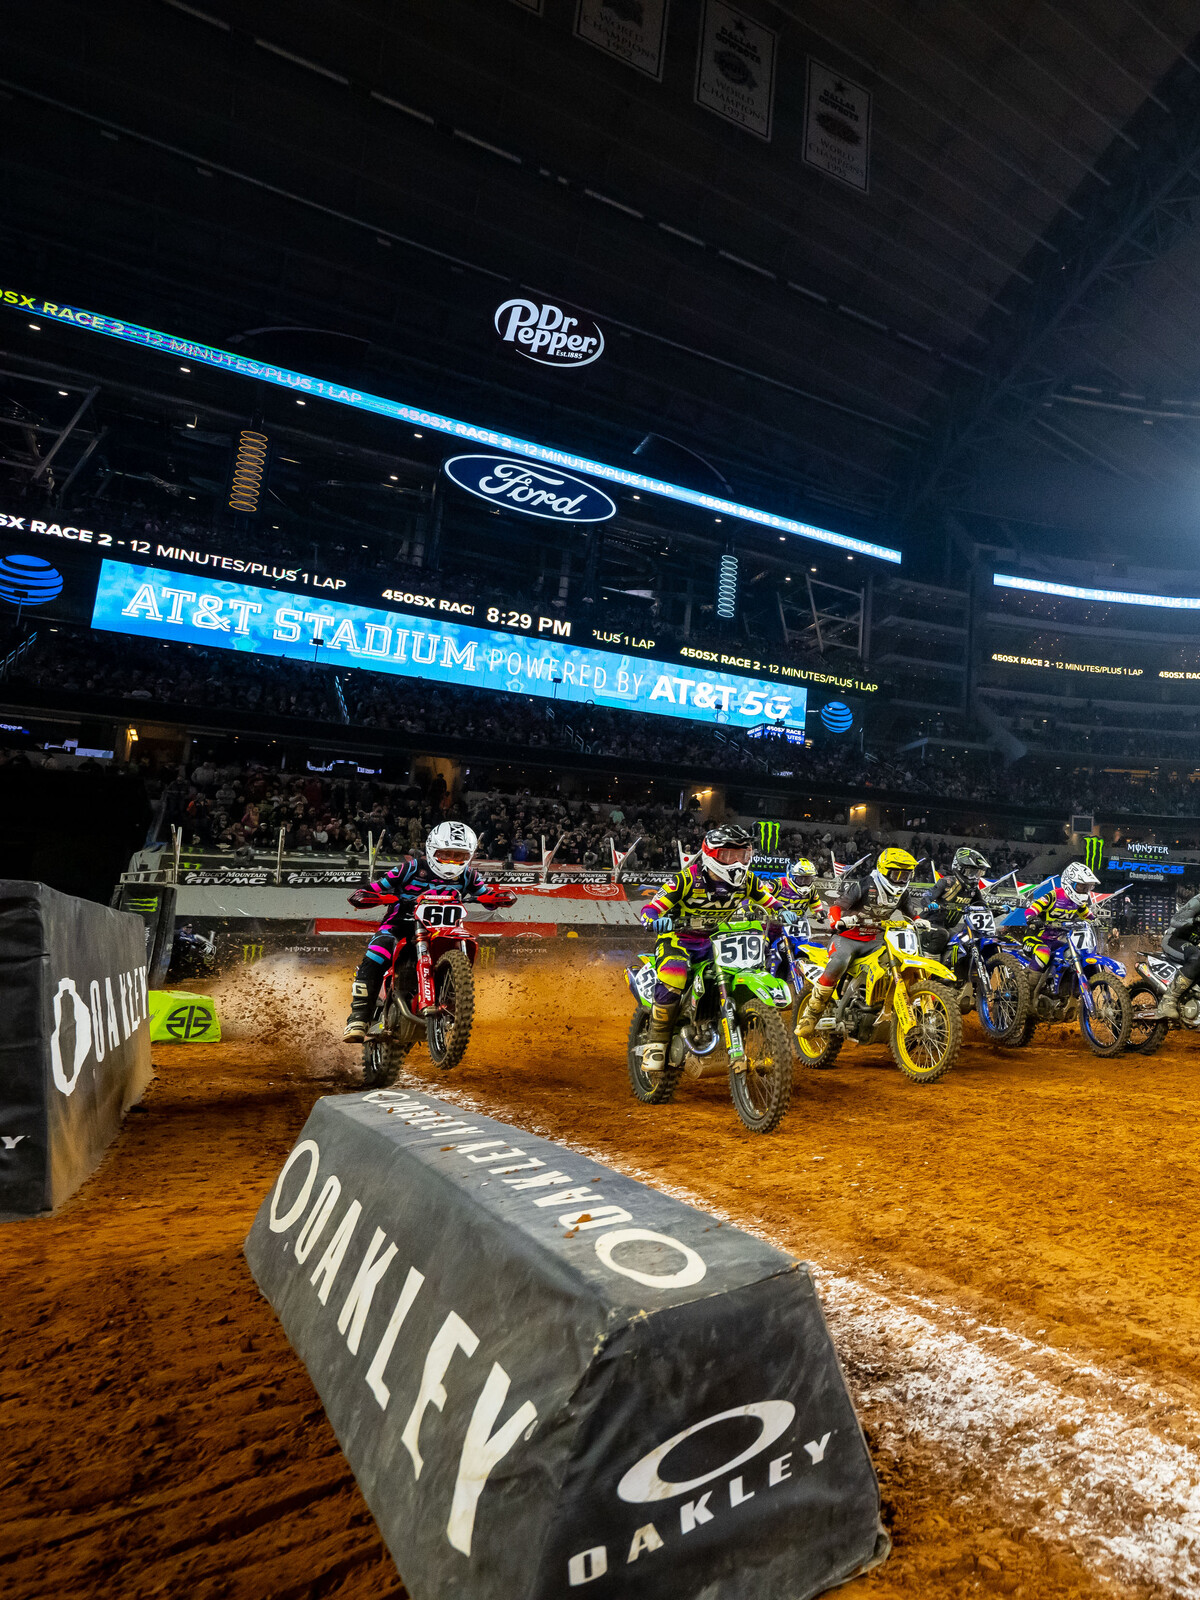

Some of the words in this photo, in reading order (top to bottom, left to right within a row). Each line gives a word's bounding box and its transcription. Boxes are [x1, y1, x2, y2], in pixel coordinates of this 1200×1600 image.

[43, 302, 105, 330] RACE
[110, 322, 125, 335] 2
[502, 299, 598, 355] Pepper
[542, 304, 578, 333] Dr
[455, 424, 498, 446] RACE
[479, 463, 587, 516] Ford
[30, 520, 93, 543] RACE
[98, 534, 112, 547] 2
[130, 540, 150, 554] 12
[156, 545, 297, 582] MINUTES/PLUS
[302, 573, 308, 584] 1
[313, 575, 346, 590] LAP
[382, 589, 435, 608] 450SX
[439, 600, 474, 616] RAC
[486, 607, 532, 629] 8:29
[538, 616, 572, 638] PM
[121, 583, 262, 636] AT&T
[272, 607, 479, 671] STADIUM
[489, 648, 606, 690] POWERED
[617, 671, 643, 695] BY
[649, 674, 737, 711] AT&T
[739, 690, 792, 720] 5G
[624, 635, 629, 646] 1
[631, 636, 655, 650] LAP
[680, 647, 718, 662] 450SX
[720, 654, 751, 669] RACE
[753, 661, 760, 670] 2
[769, 664, 779, 674] 12
[781, 666, 853, 688] MINUTES/PLUS
[860, 682, 878, 692] LAP
[992, 653, 1019, 664] 450SX
[1021, 657, 1043, 667] RACE
[1044, 659, 1049, 667] 2
[1055, 661, 1063, 669] 12
[1129, 668, 1143, 676] LAP
[1127, 843, 1169, 855] MONSTER
[1108, 861, 1185, 875] SUPERCROSS
[1129, 872, 1164, 881] Championship
[423, 906, 462, 926] 60
[789, 922, 808, 937] 44
[972, 914, 995, 931] 32
[720, 936, 761, 964] 519
[1074, 932, 1084, 949] 7
[1152, 963, 1174, 979] 46
[89, 965, 148, 1064] OAKLEY
[457, 1140, 634, 1233] OAKLEY
[293, 1174, 538, 1558] OAKLEY
[567, 1432, 832, 1588] OAKLEY
